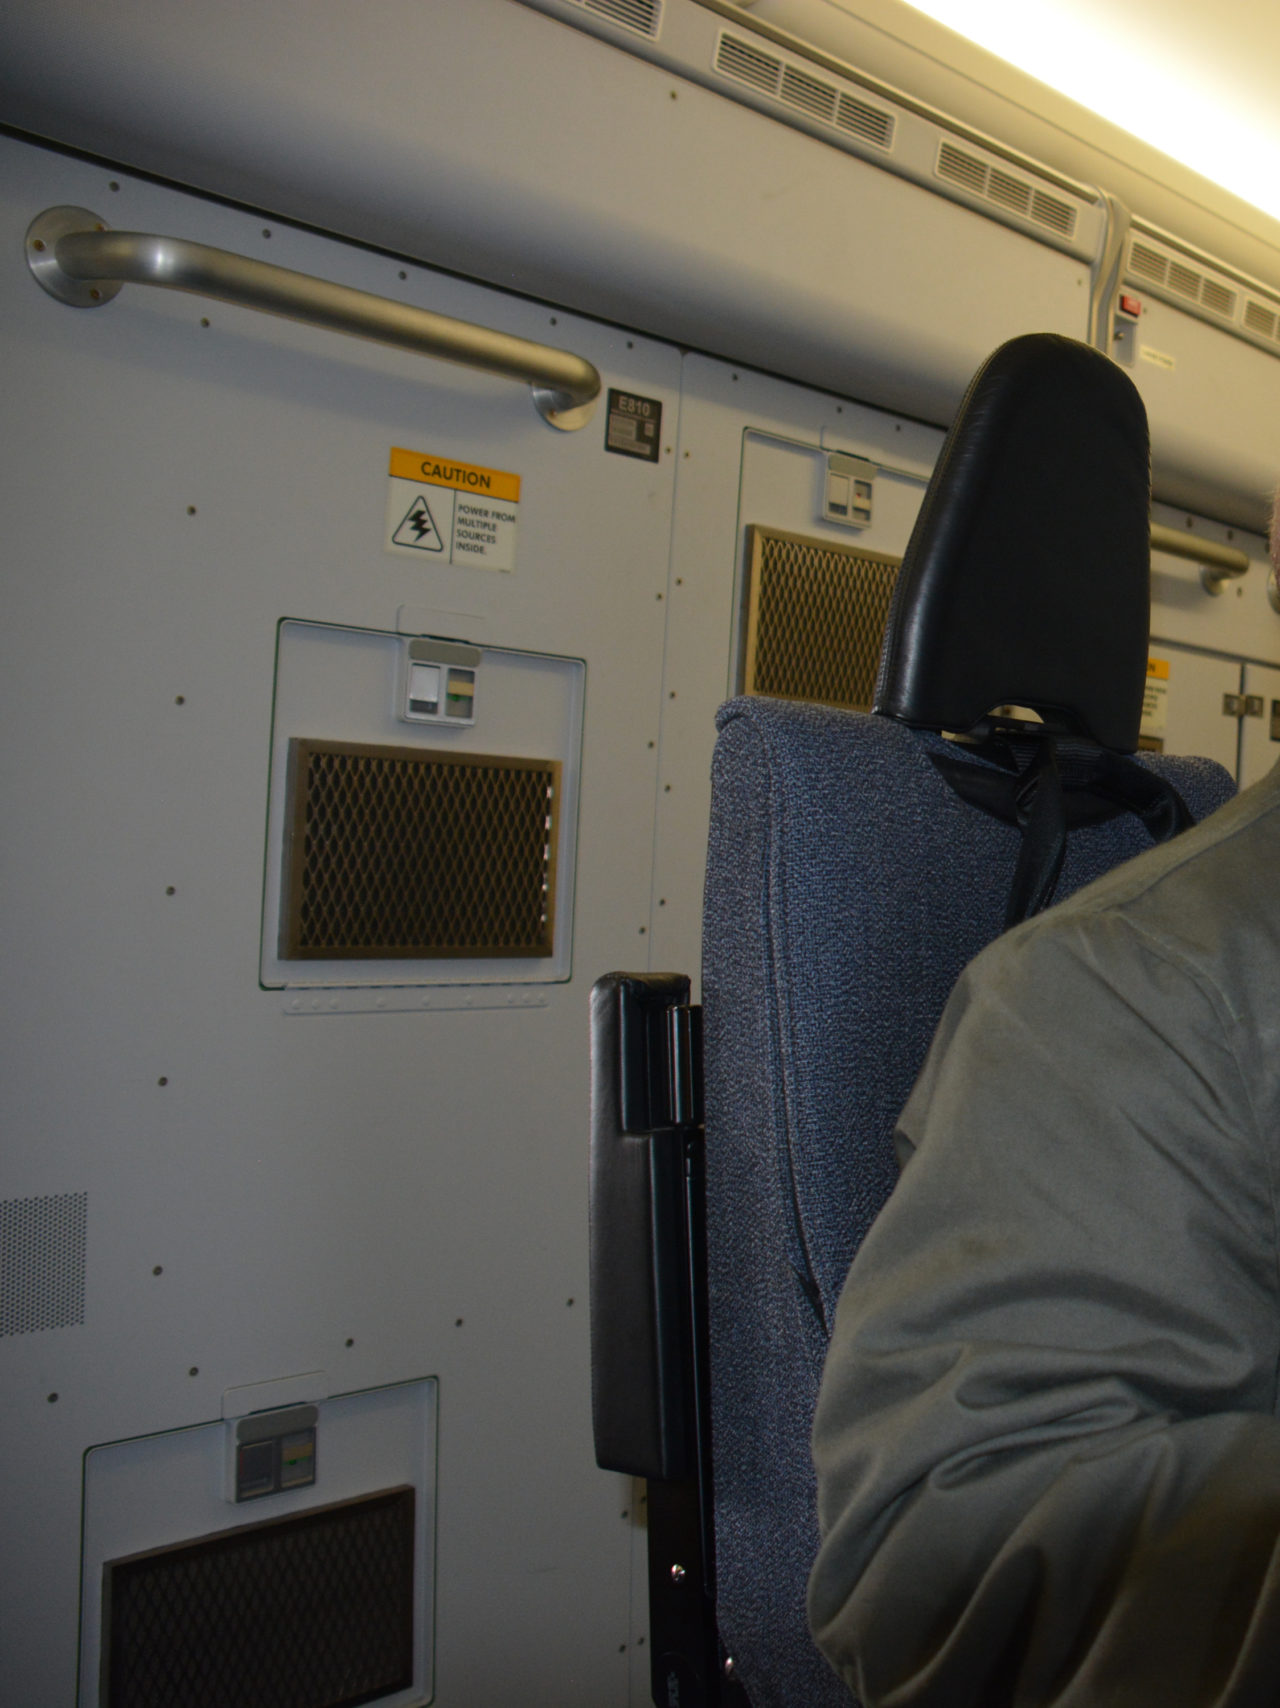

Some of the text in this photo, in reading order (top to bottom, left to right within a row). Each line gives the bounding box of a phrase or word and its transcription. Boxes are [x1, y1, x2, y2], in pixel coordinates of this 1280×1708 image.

[420, 461, 491, 489] CAUTION
[457, 503, 516, 523] POWER FROM
[456, 516, 497, 532] MULTIPLE
[456, 528, 496, 544] SOURCES
